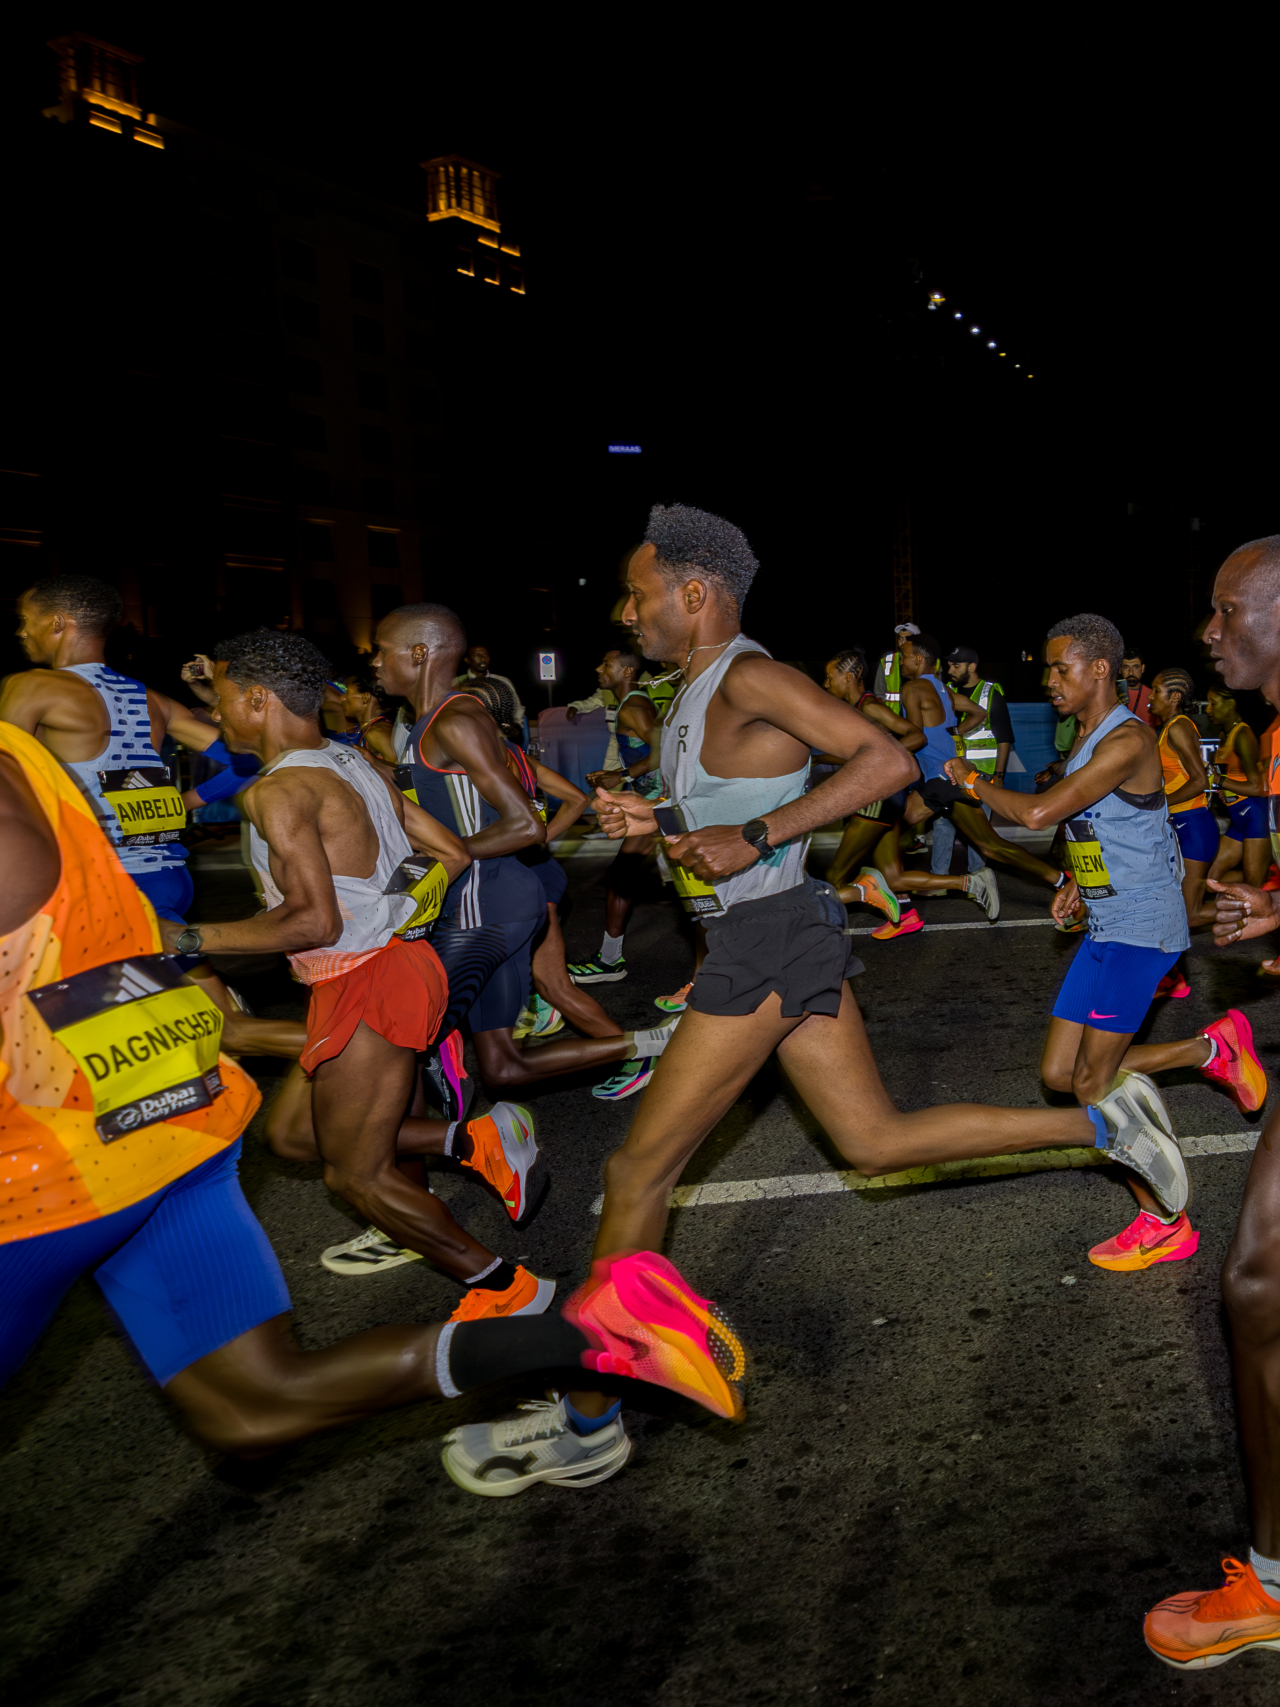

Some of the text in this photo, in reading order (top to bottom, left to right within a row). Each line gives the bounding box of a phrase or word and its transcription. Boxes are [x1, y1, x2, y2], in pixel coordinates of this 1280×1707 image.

[117, 797, 183, 823] AMBELU
[83, 1008, 221, 1082] DAGNACHEW
[139, 1086, 196, 1113] Dubai
[143, 1095, 198, 1122] Duty Free
